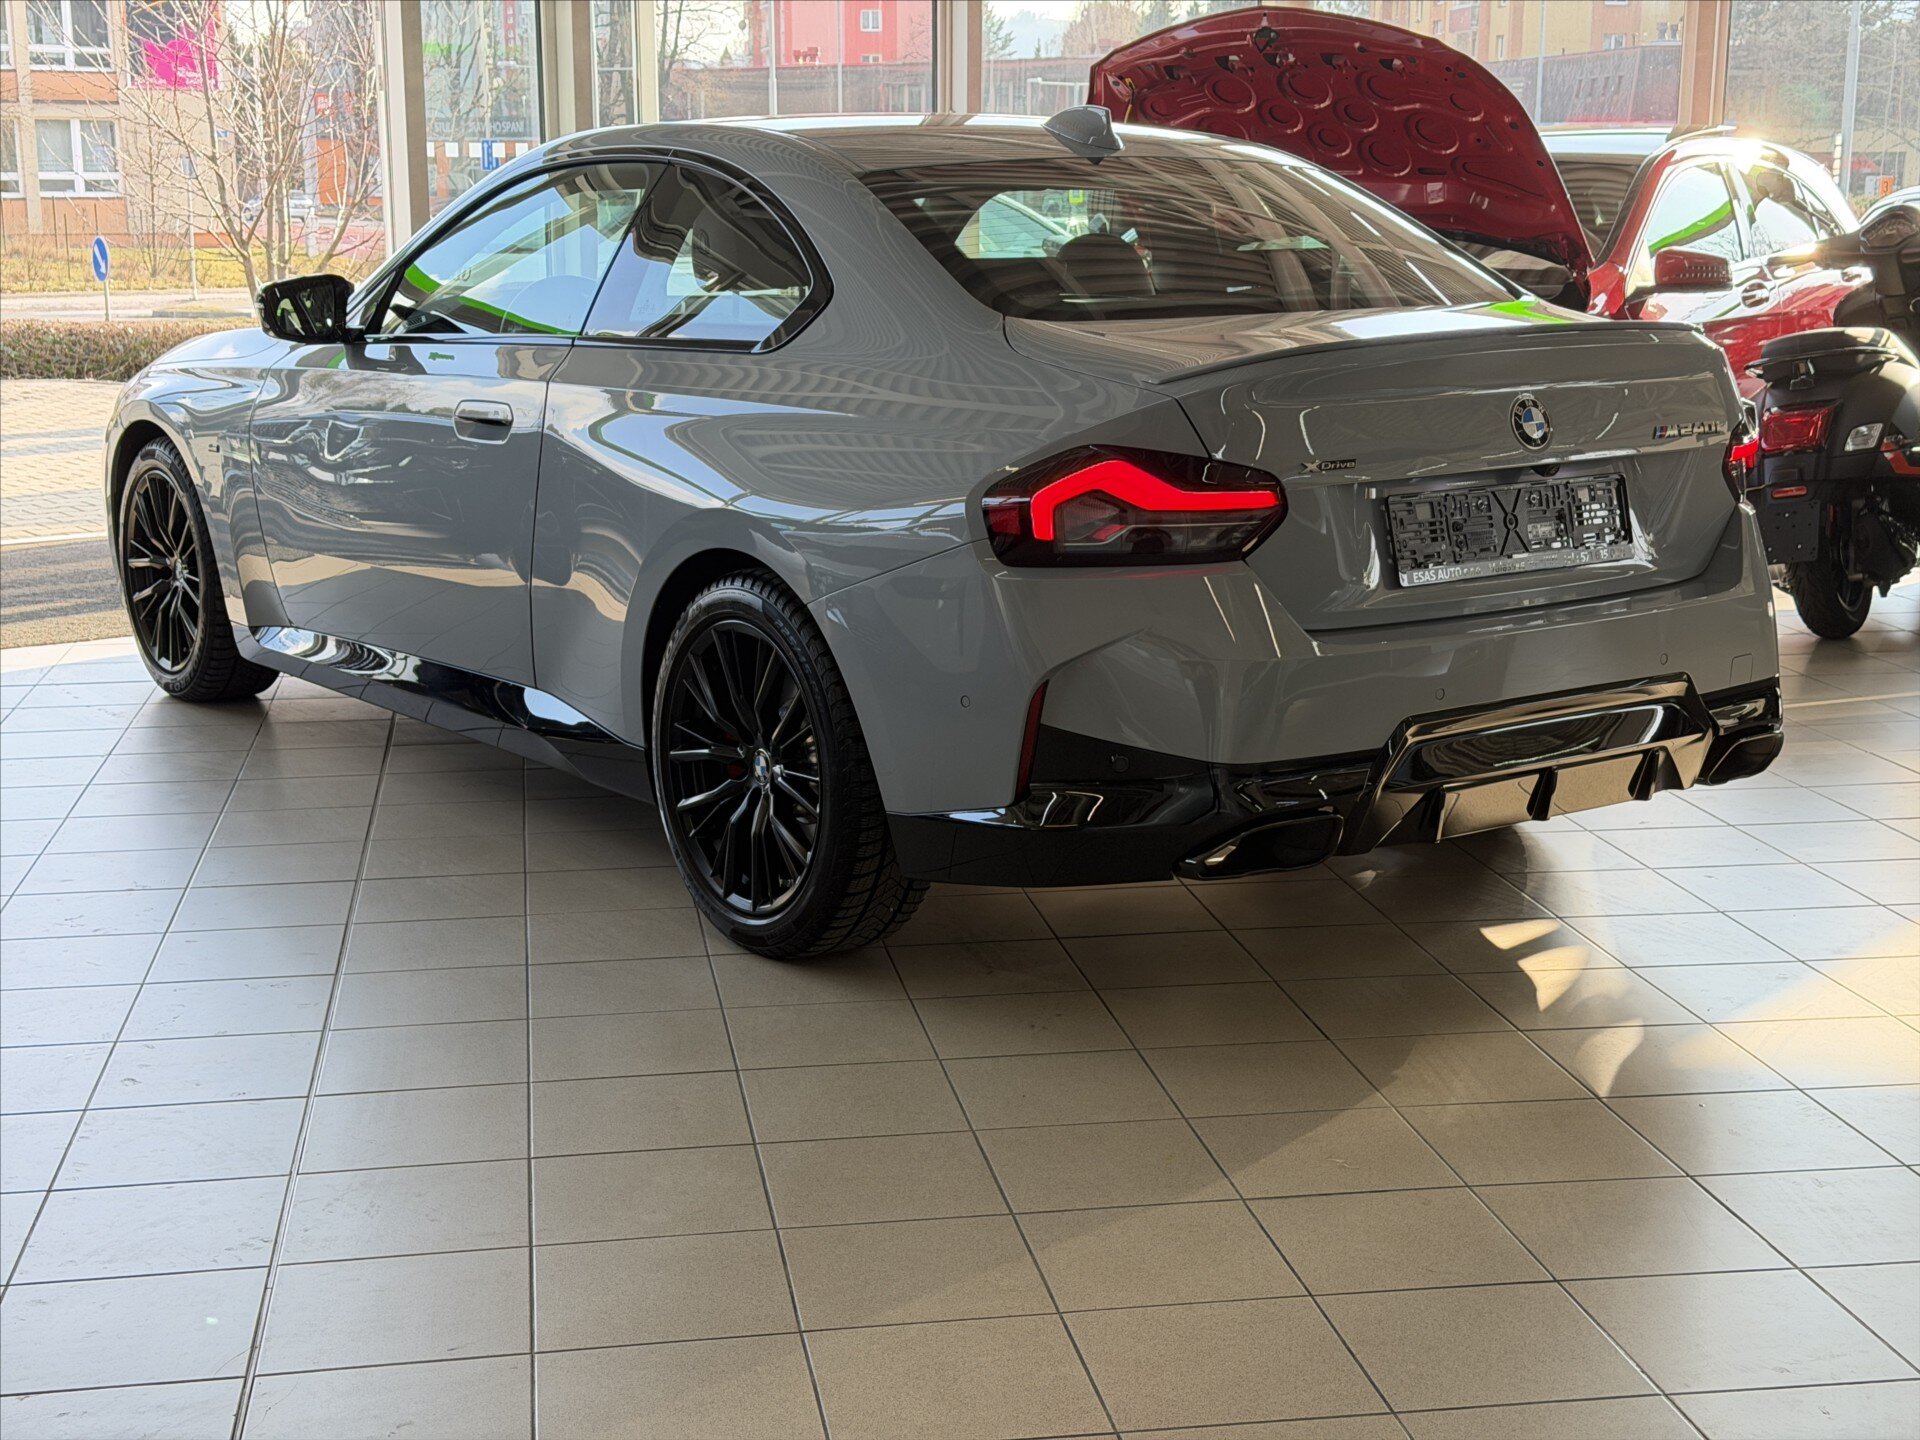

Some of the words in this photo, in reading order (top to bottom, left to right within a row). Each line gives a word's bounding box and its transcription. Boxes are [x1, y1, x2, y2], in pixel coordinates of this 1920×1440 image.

[1514, 399, 1545, 415] BMW
[1413, 571, 1436, 583] ESAS
[1438, 567, 1462, 580] AUTO
